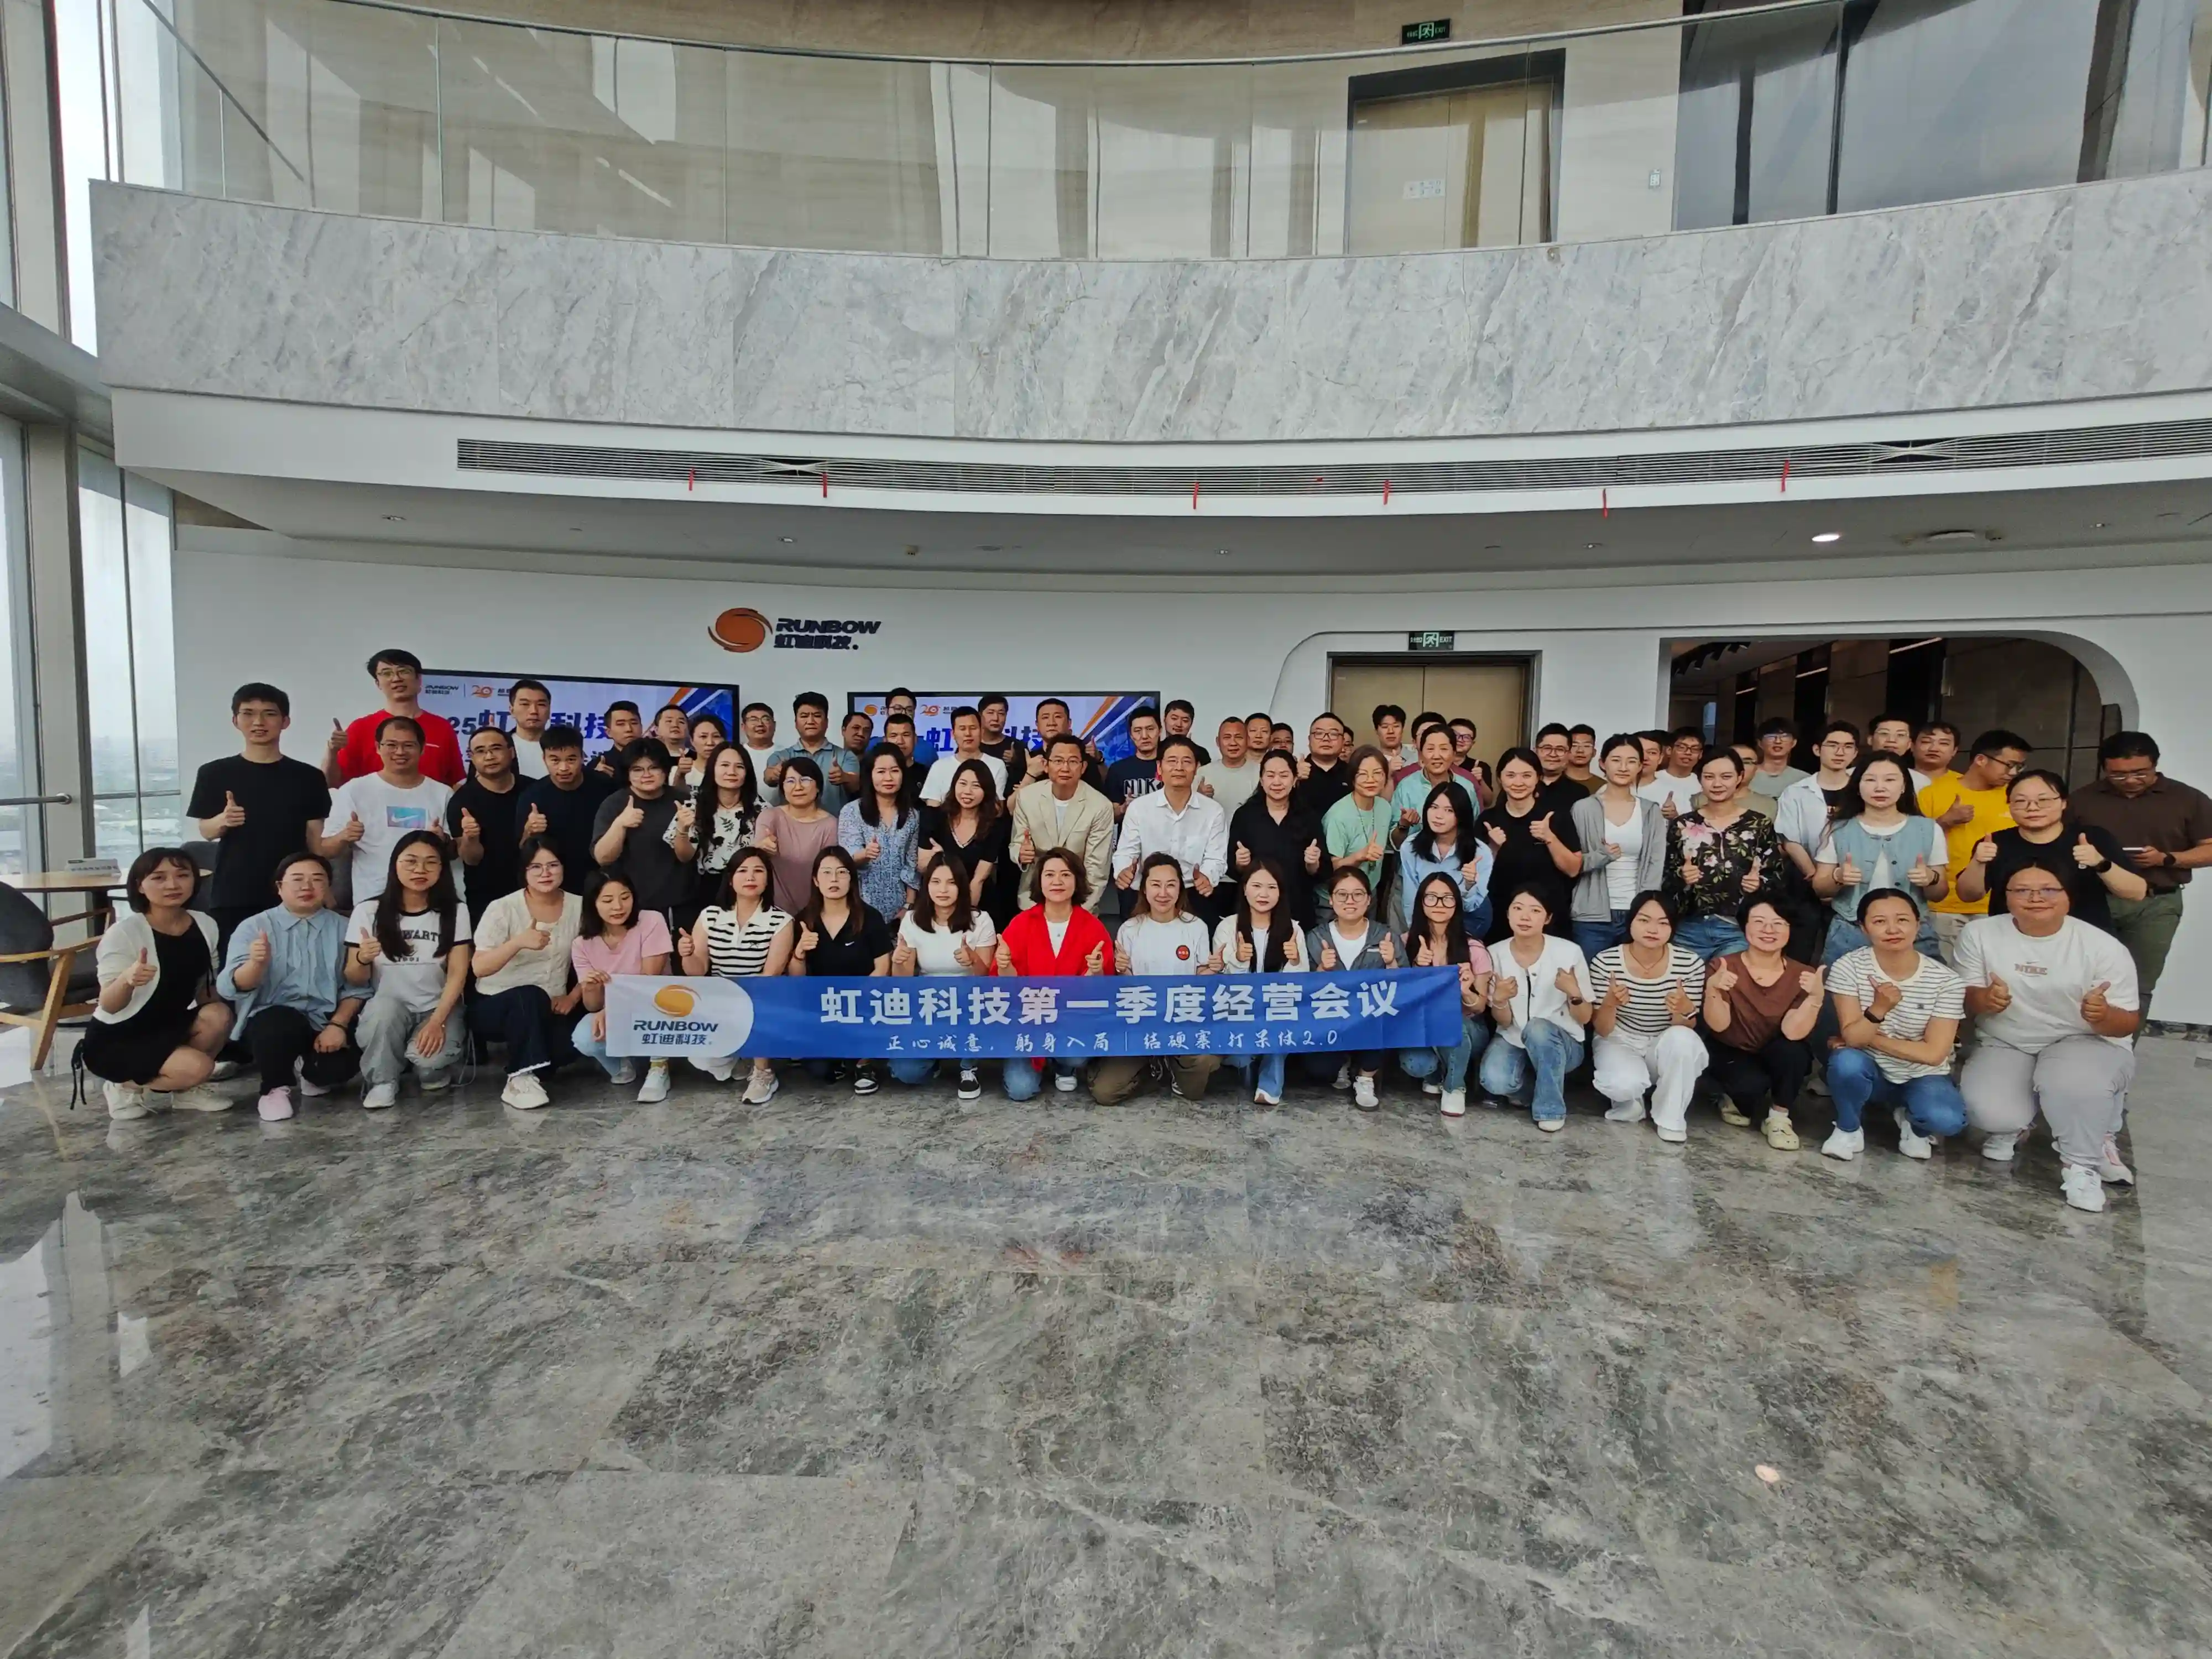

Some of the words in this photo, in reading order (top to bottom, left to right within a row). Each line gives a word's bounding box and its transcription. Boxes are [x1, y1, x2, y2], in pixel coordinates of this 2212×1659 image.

[776, 618, 881, 634] RUNBOW
[820, 981, 1400, 1025] 虹迪科技第一季度经营会议
[633, 1020, 718, 1032] RUNBOW
[641, 1033, 707, 1045] 虹迪科技
